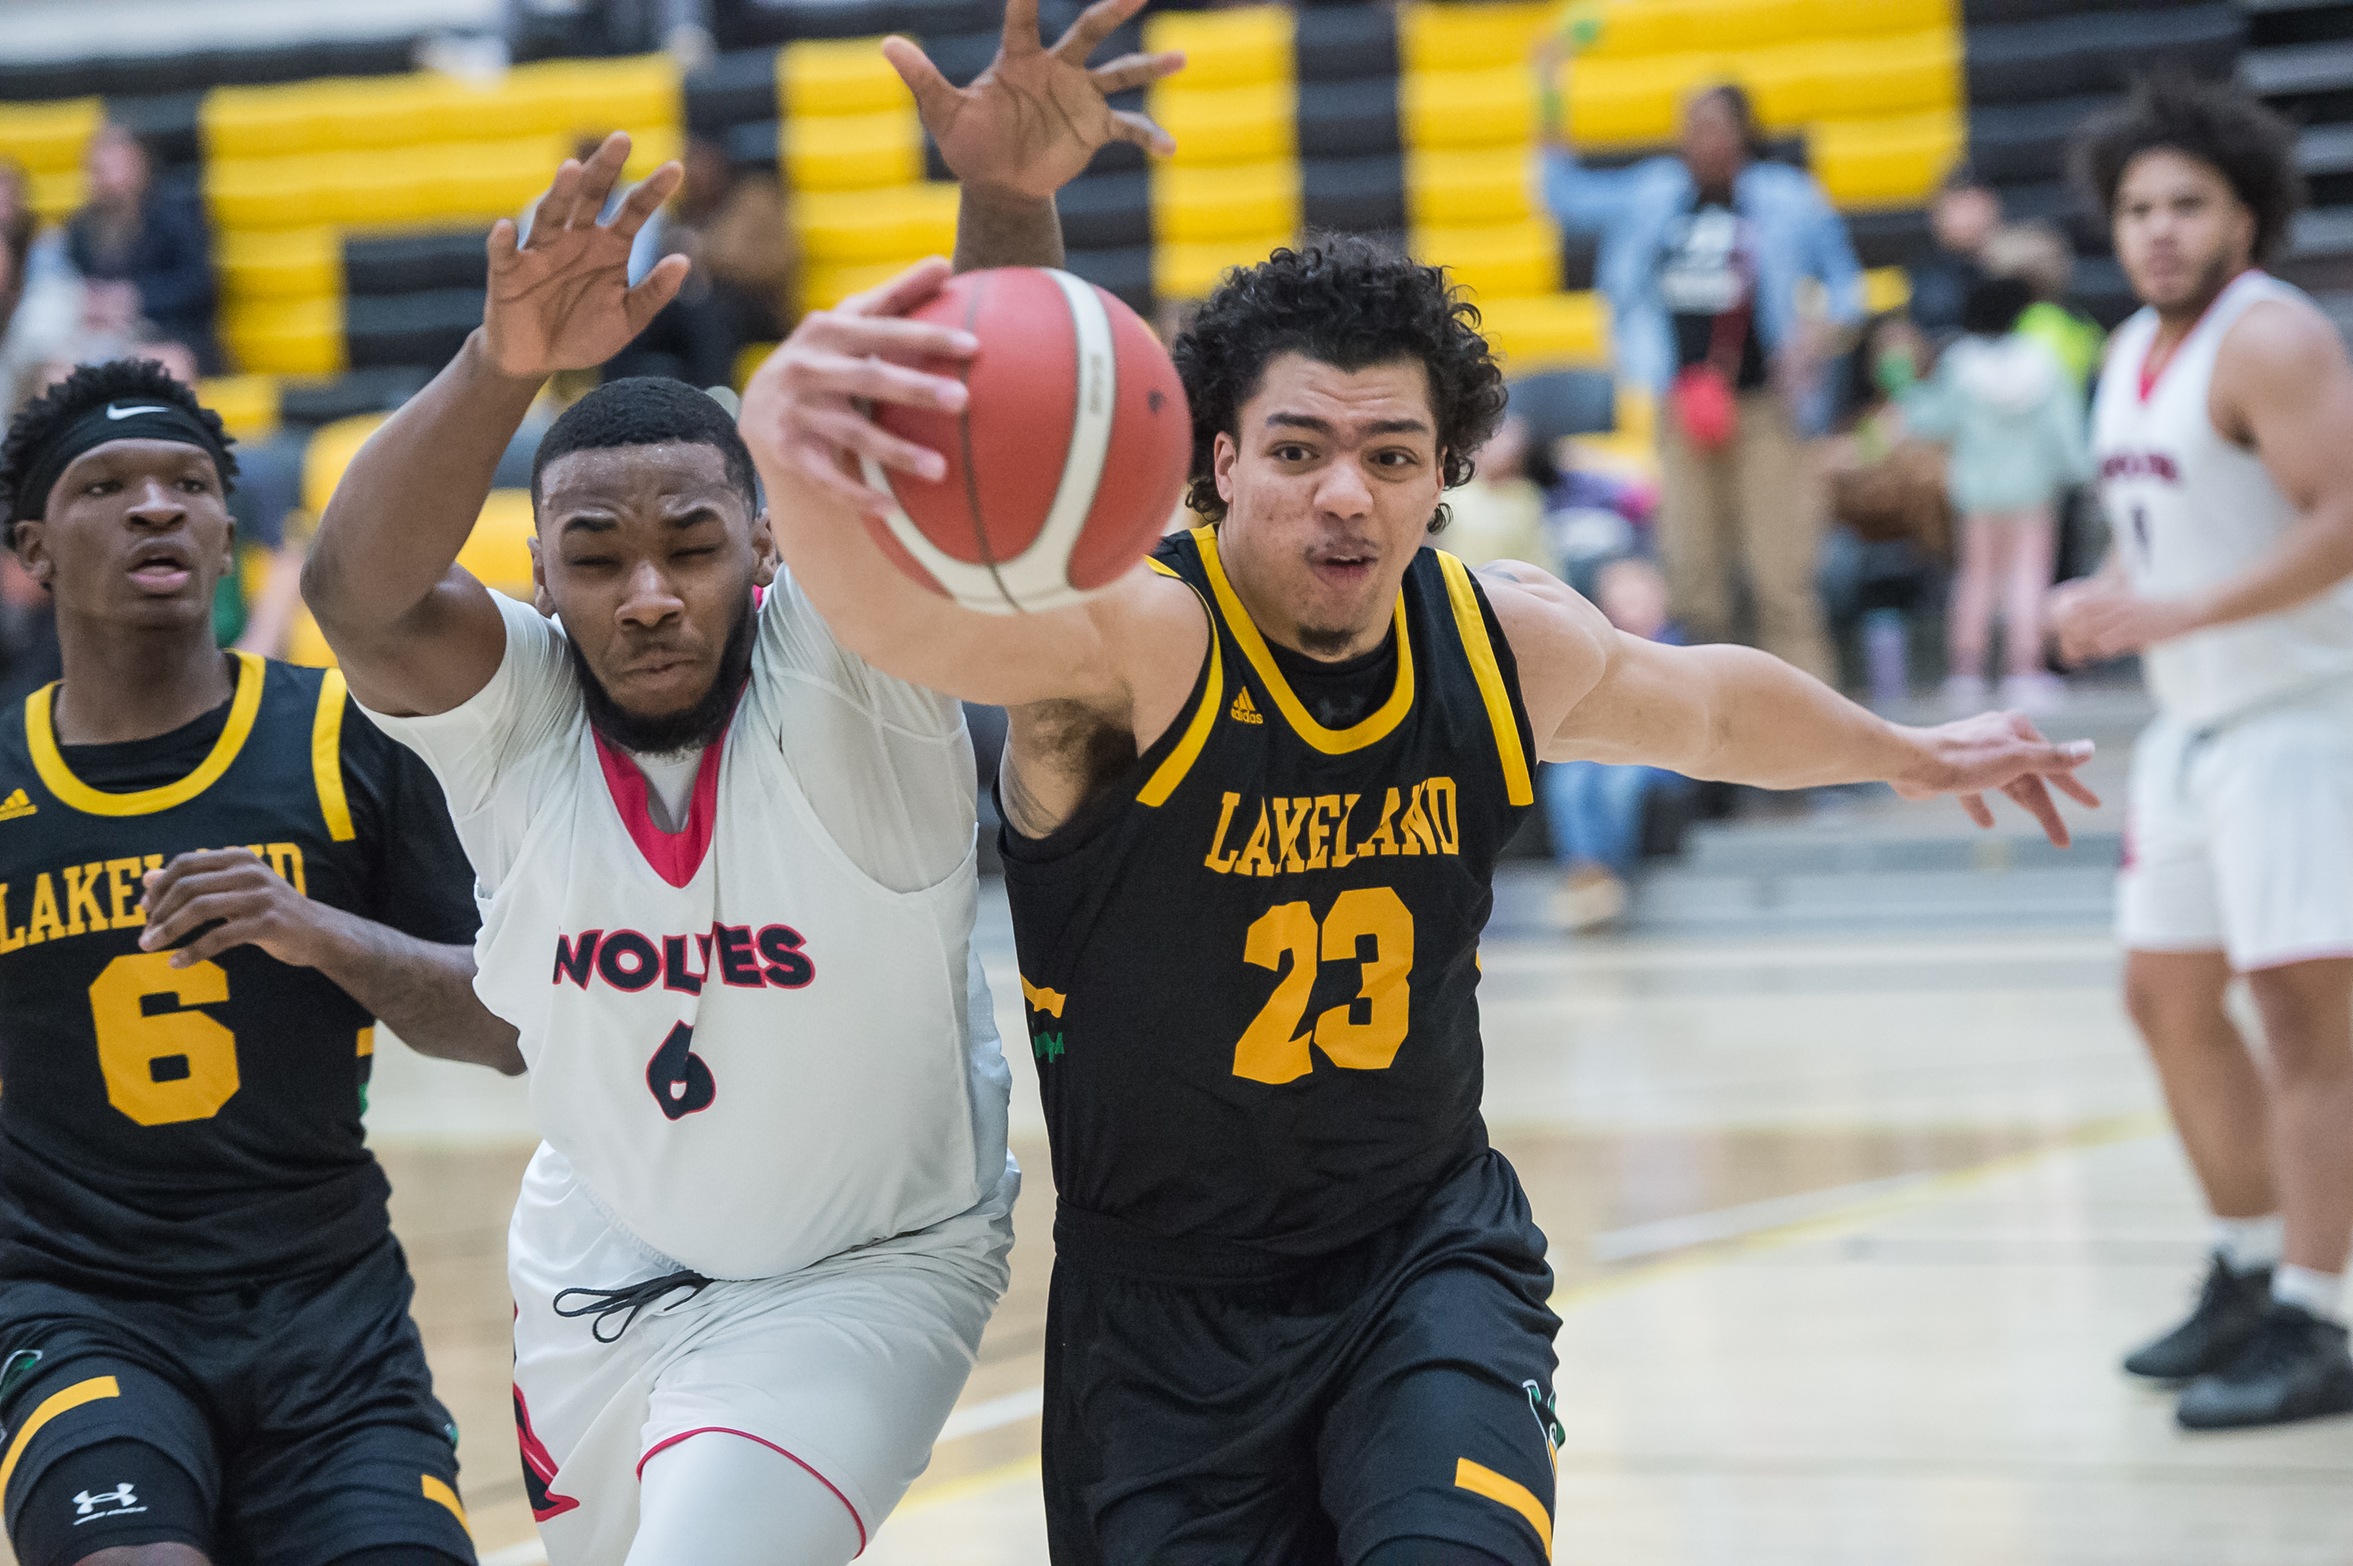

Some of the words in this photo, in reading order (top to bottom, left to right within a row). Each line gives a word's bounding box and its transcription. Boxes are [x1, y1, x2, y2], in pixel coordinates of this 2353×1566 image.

[1204, 777, 1459, 877] LAKELAND
[0, 842, 307, 955] LAKED
[88, 950, 241, 1127] 6
[1232, 886, 1414, 1085] 23
[645, 1018, 717, 1121] 6
